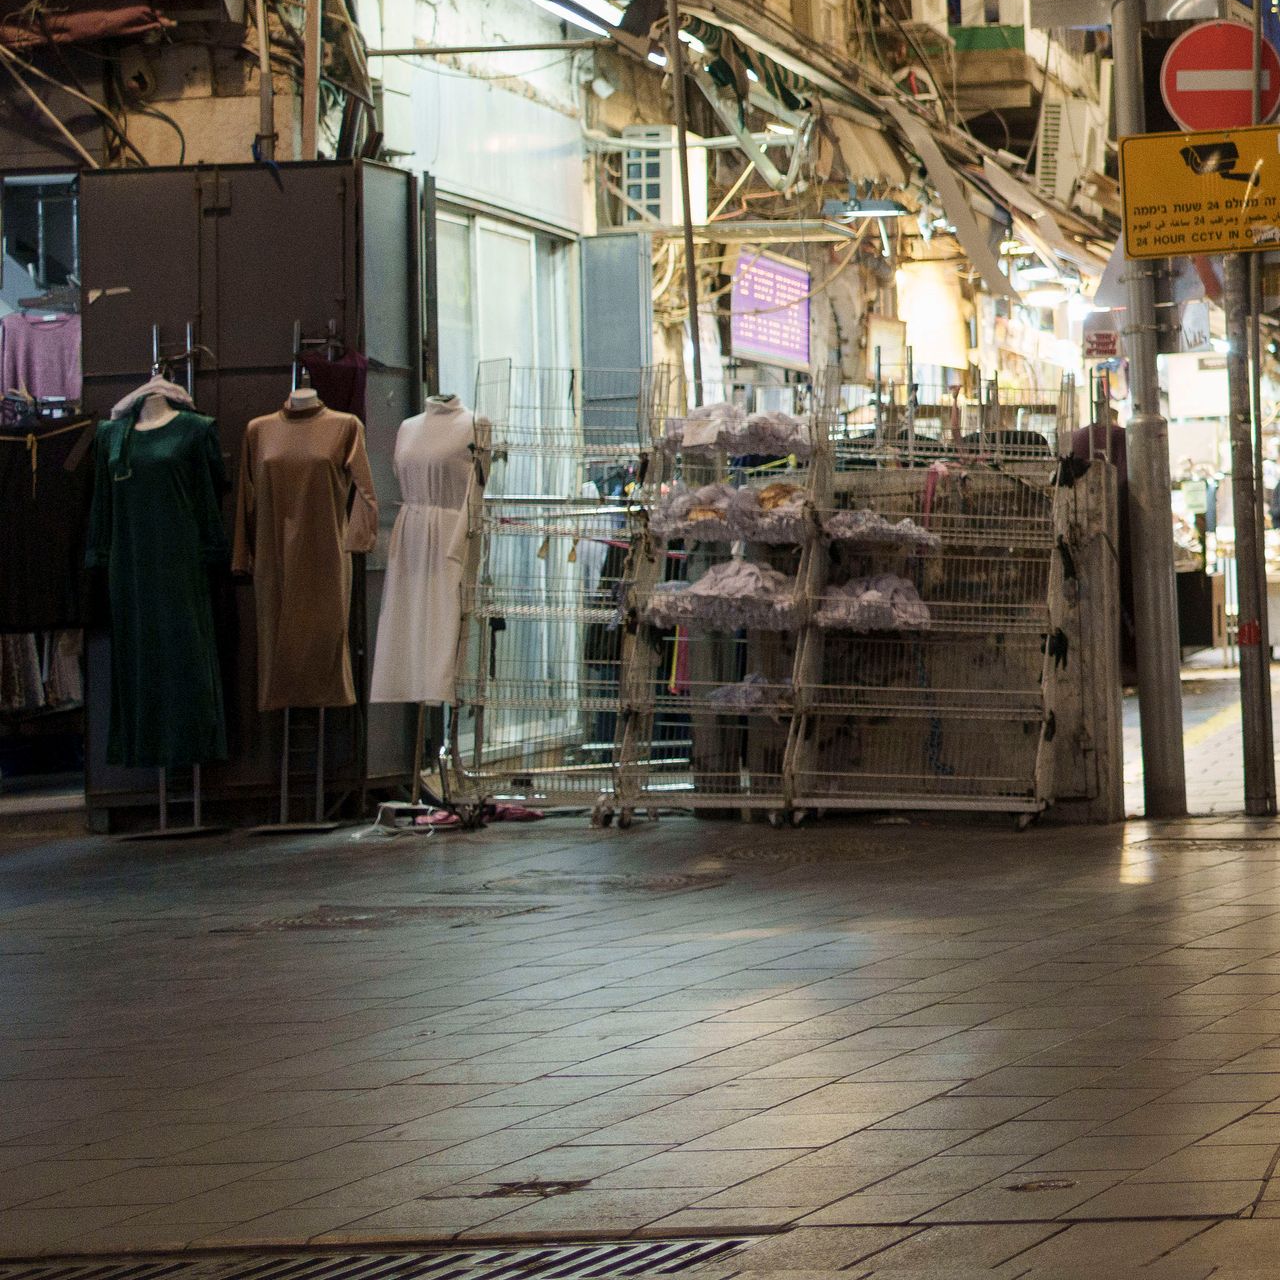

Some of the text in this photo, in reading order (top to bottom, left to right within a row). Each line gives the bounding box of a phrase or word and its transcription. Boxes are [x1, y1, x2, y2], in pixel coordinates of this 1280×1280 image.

[1207, 201, 1219, 210] 24
[1265, 197, 1276, 206] זה
[1133, 204, 1167, 216] ביממה
[1173, 202, 1201, 213] שעות
[1193, 216, 1204, 226] 24
[1136, 237, 1147, 247] 24
[1153, 234, 1185, 245] HOUR
[1191, 231, 1223, 242] CCTV
[1229, 230, 1239, 239] IN
